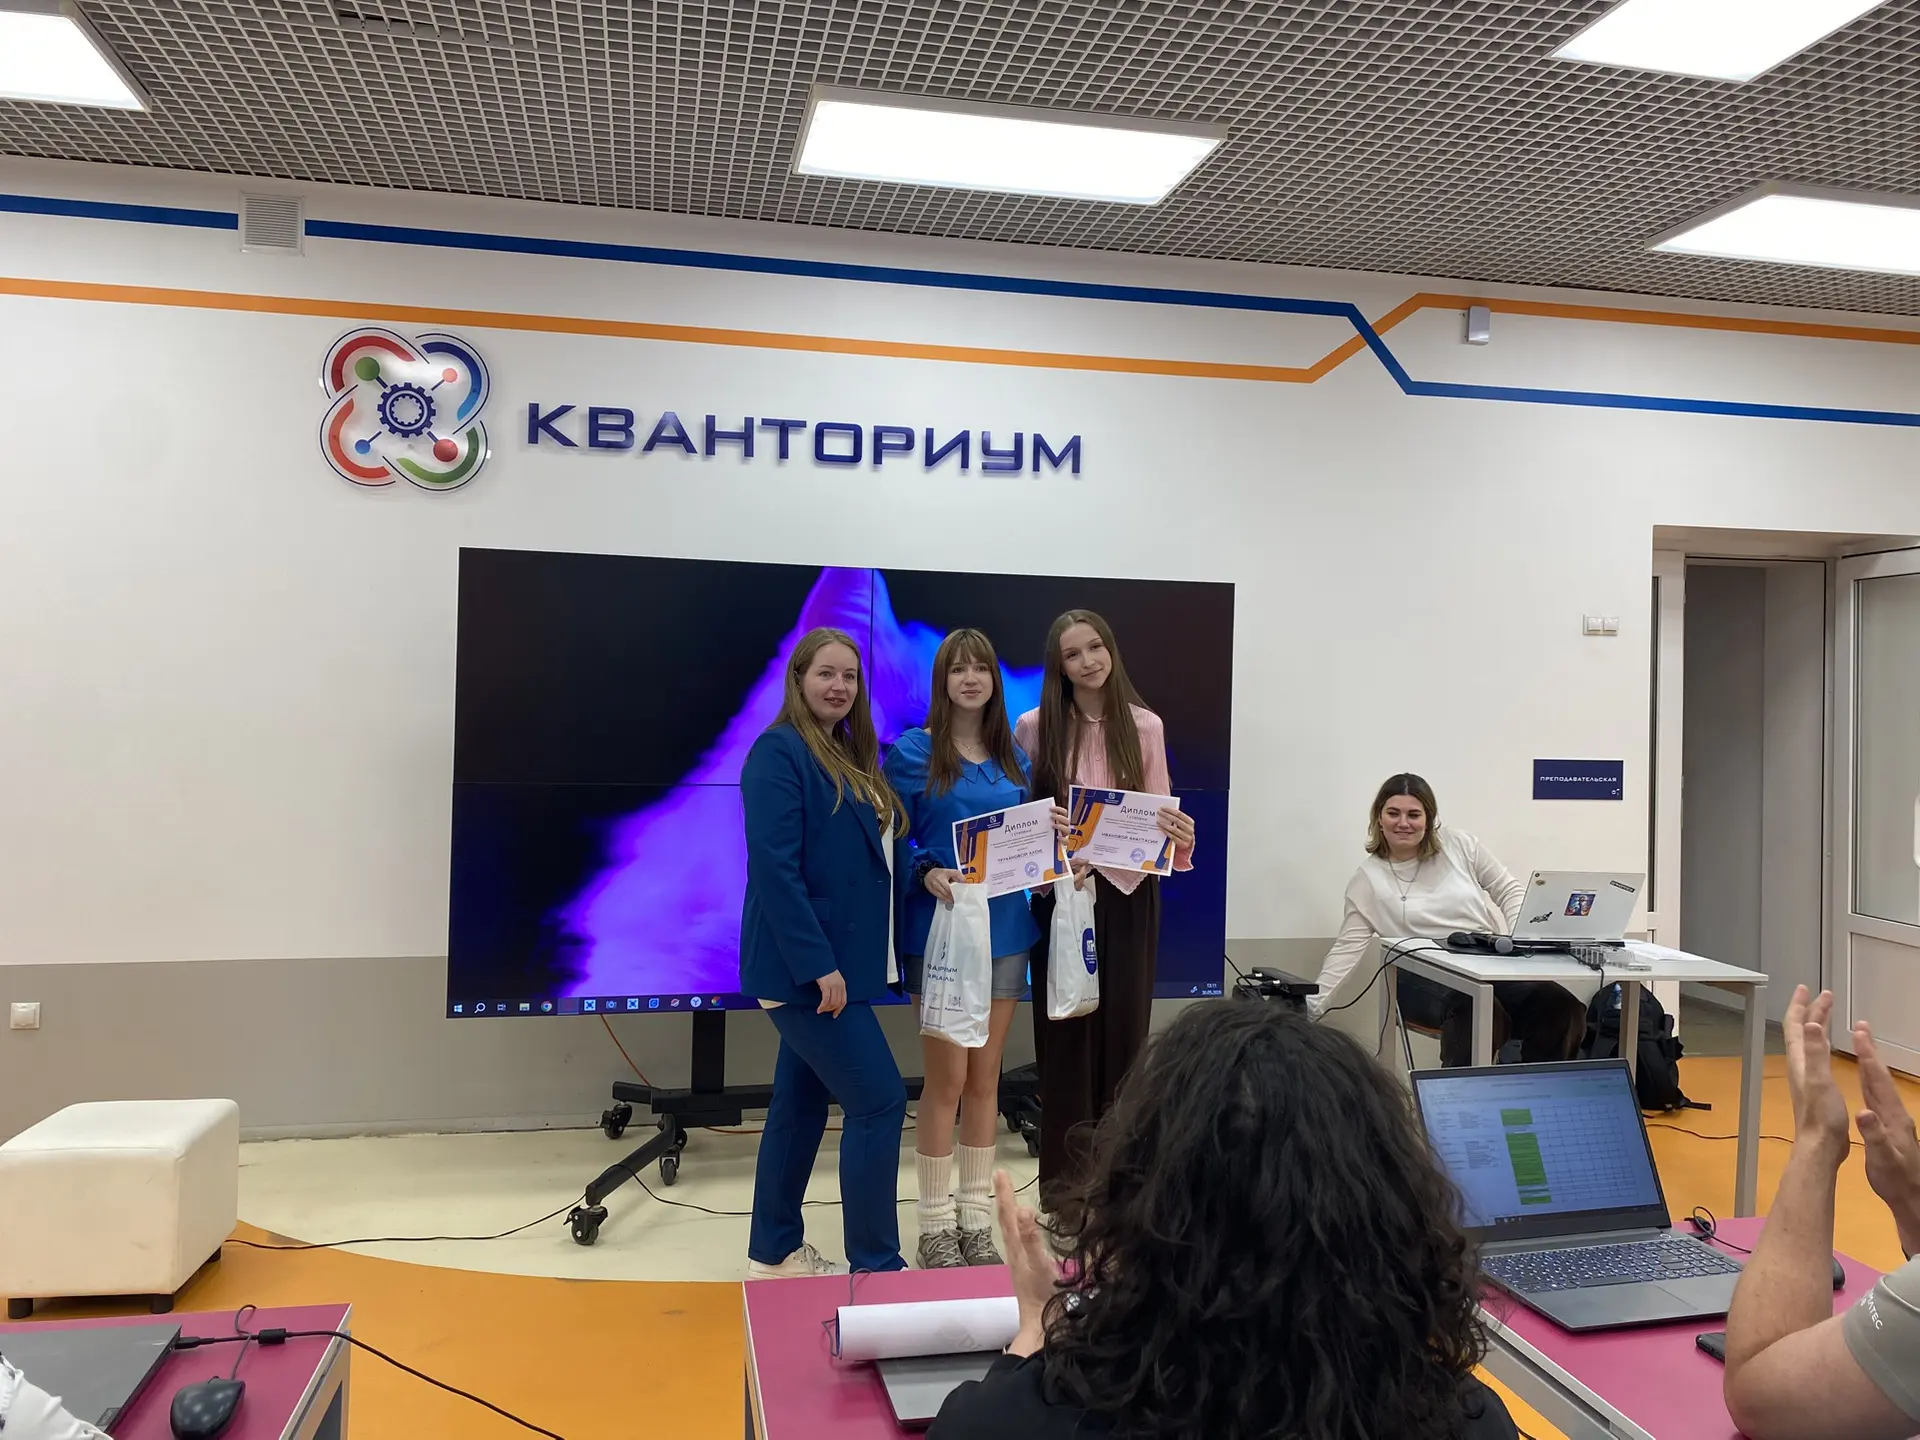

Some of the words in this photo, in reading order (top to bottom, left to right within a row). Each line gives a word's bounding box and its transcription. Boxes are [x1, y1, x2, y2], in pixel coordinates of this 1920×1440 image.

[527, 402, 1082, 475] КВАНТОРИУМ
[1120, 805, 1156, 817] Диплом
[1004, 819, 1039, 834] Диплом
